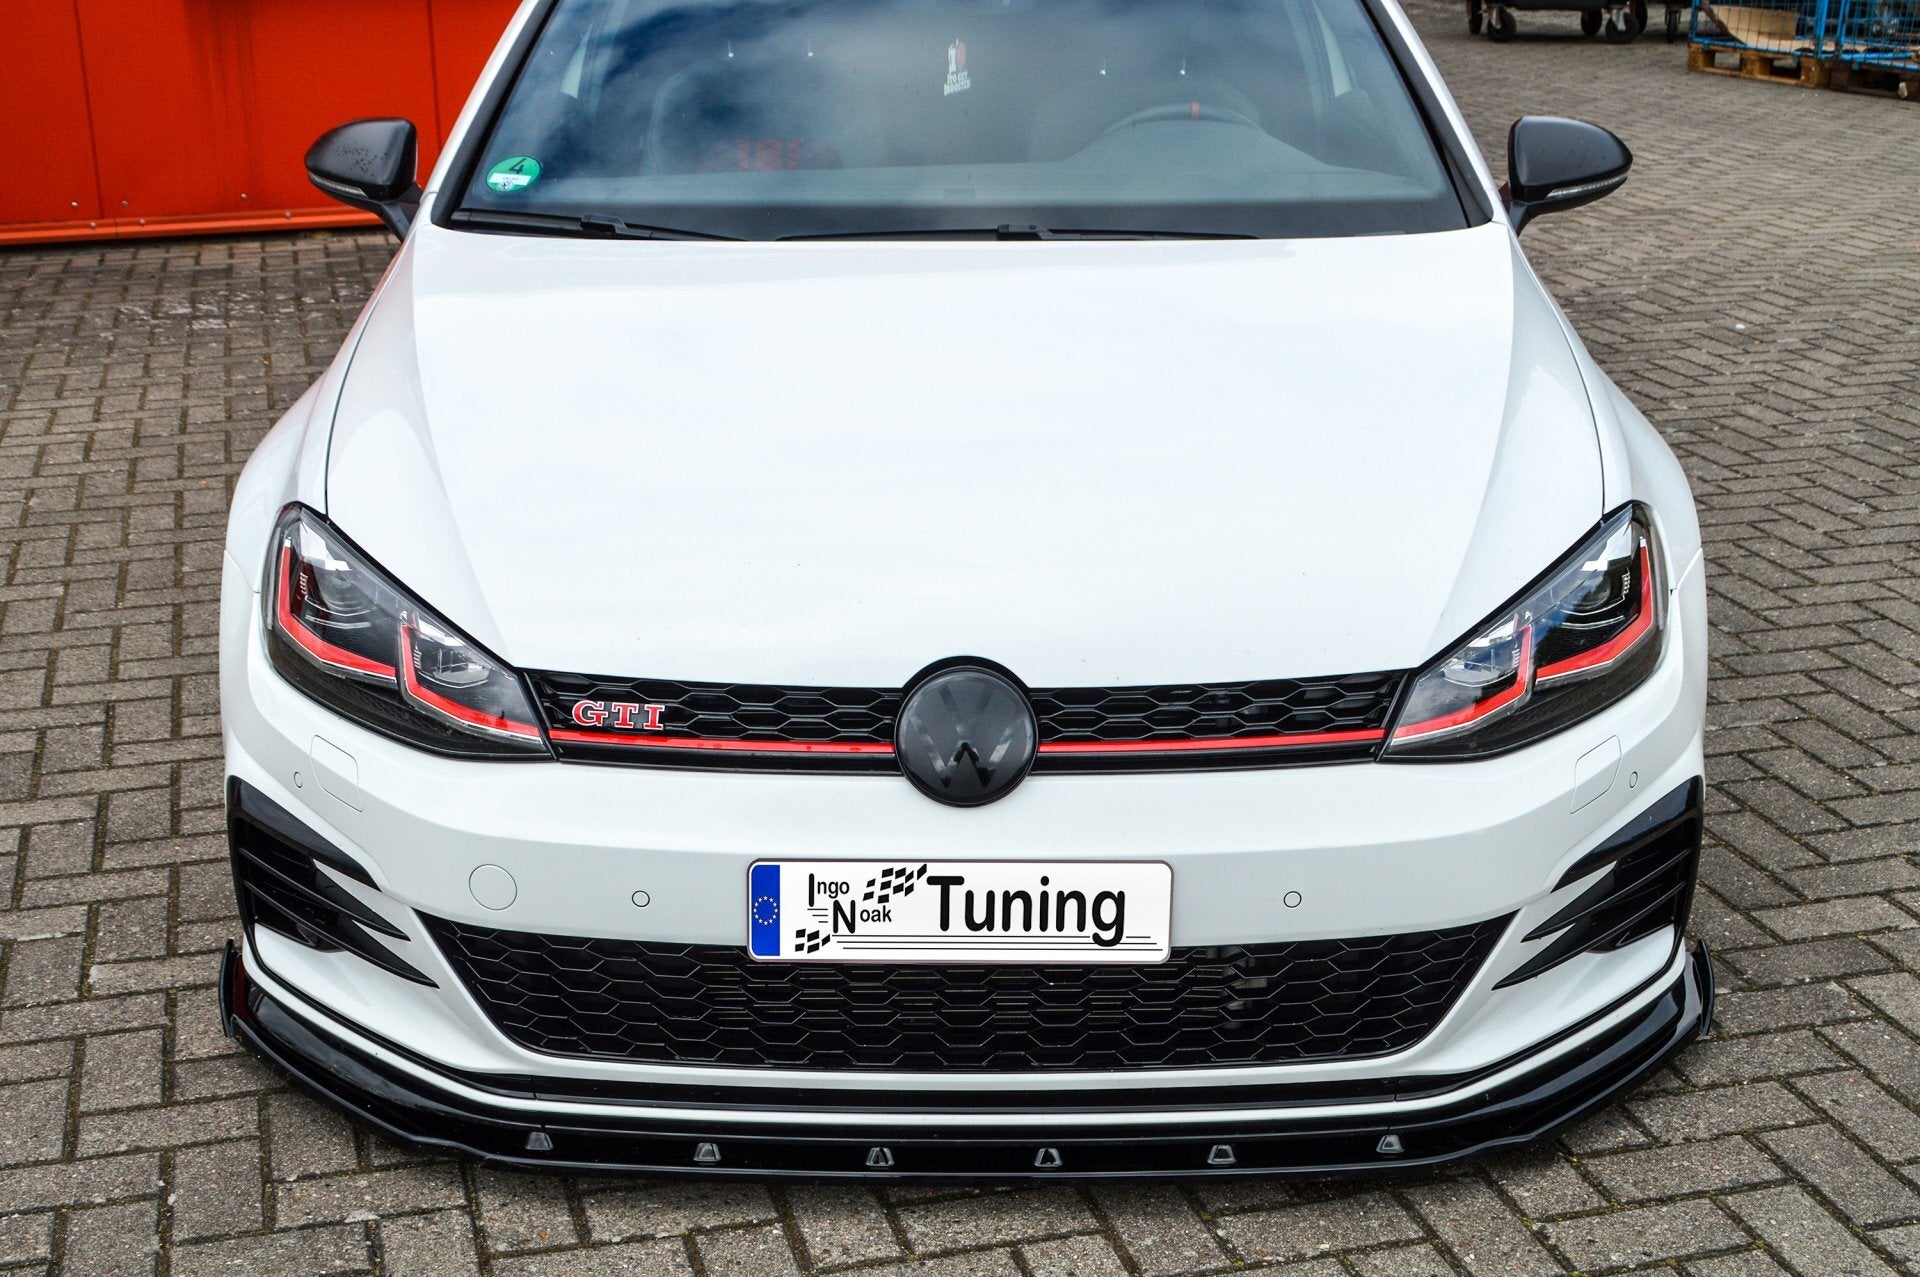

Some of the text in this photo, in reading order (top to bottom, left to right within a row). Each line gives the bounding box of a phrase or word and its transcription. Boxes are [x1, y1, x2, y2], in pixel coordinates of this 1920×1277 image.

[509, 157, 526, 174] 4
[572, 700, 665, 731] GTI
[808, 873, 850, 907] Ingo
[833, 899, 892, 934] Noak
[926, 875, 1125, 947] Tuning
